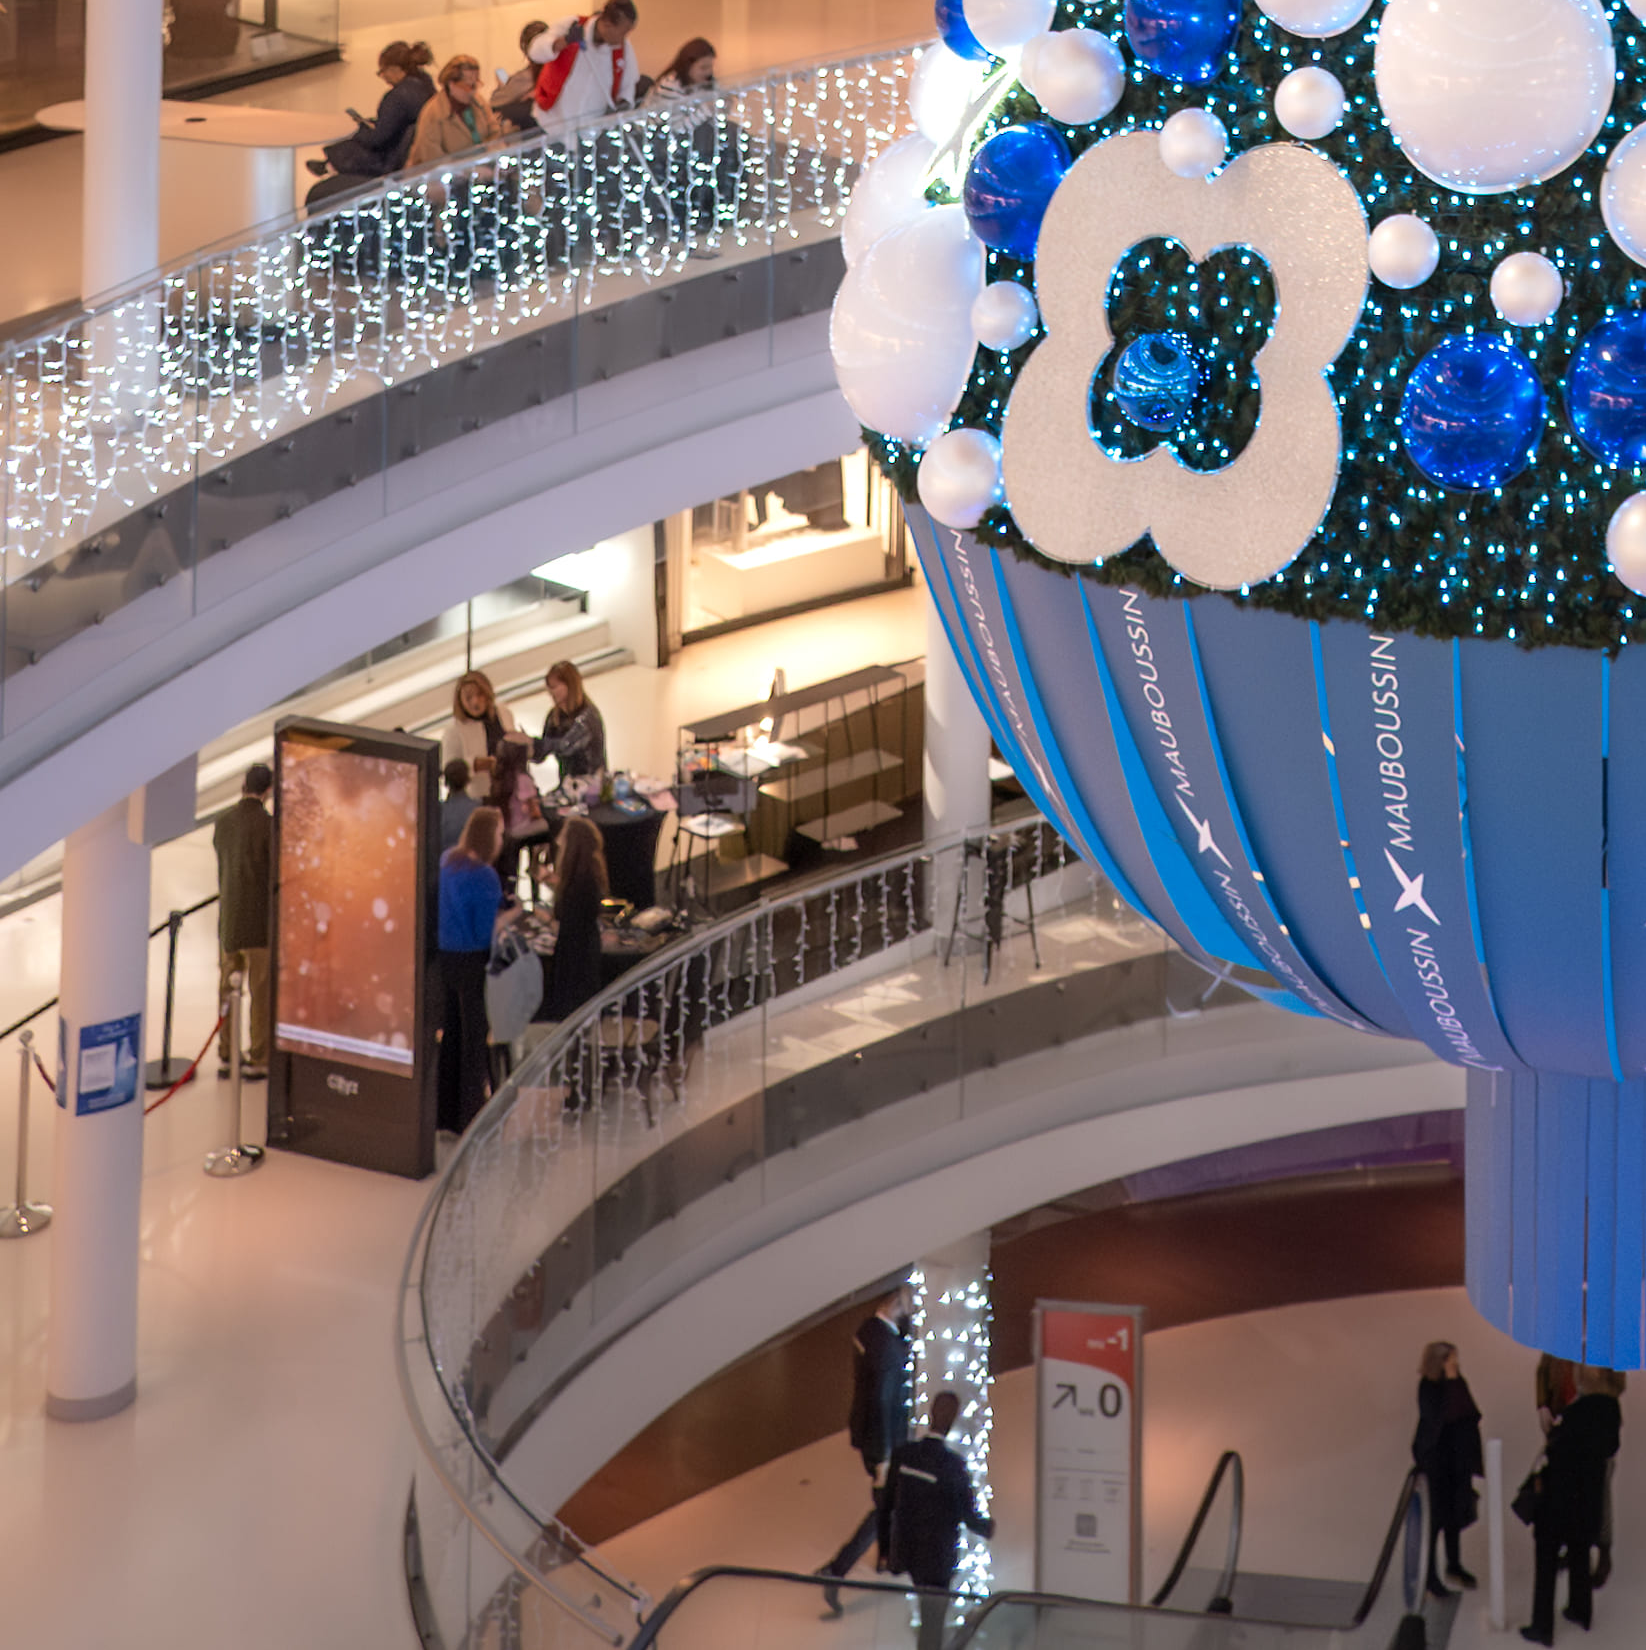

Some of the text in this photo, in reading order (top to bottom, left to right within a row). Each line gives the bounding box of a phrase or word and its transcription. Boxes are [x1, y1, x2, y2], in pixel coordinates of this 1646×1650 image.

[1119, 589, 1195, 797] MAUBOUSSIN
[1369, 634, 1414, 851] MAUBOUSSIN
[1098, 1382, 1123, 1418] 0
